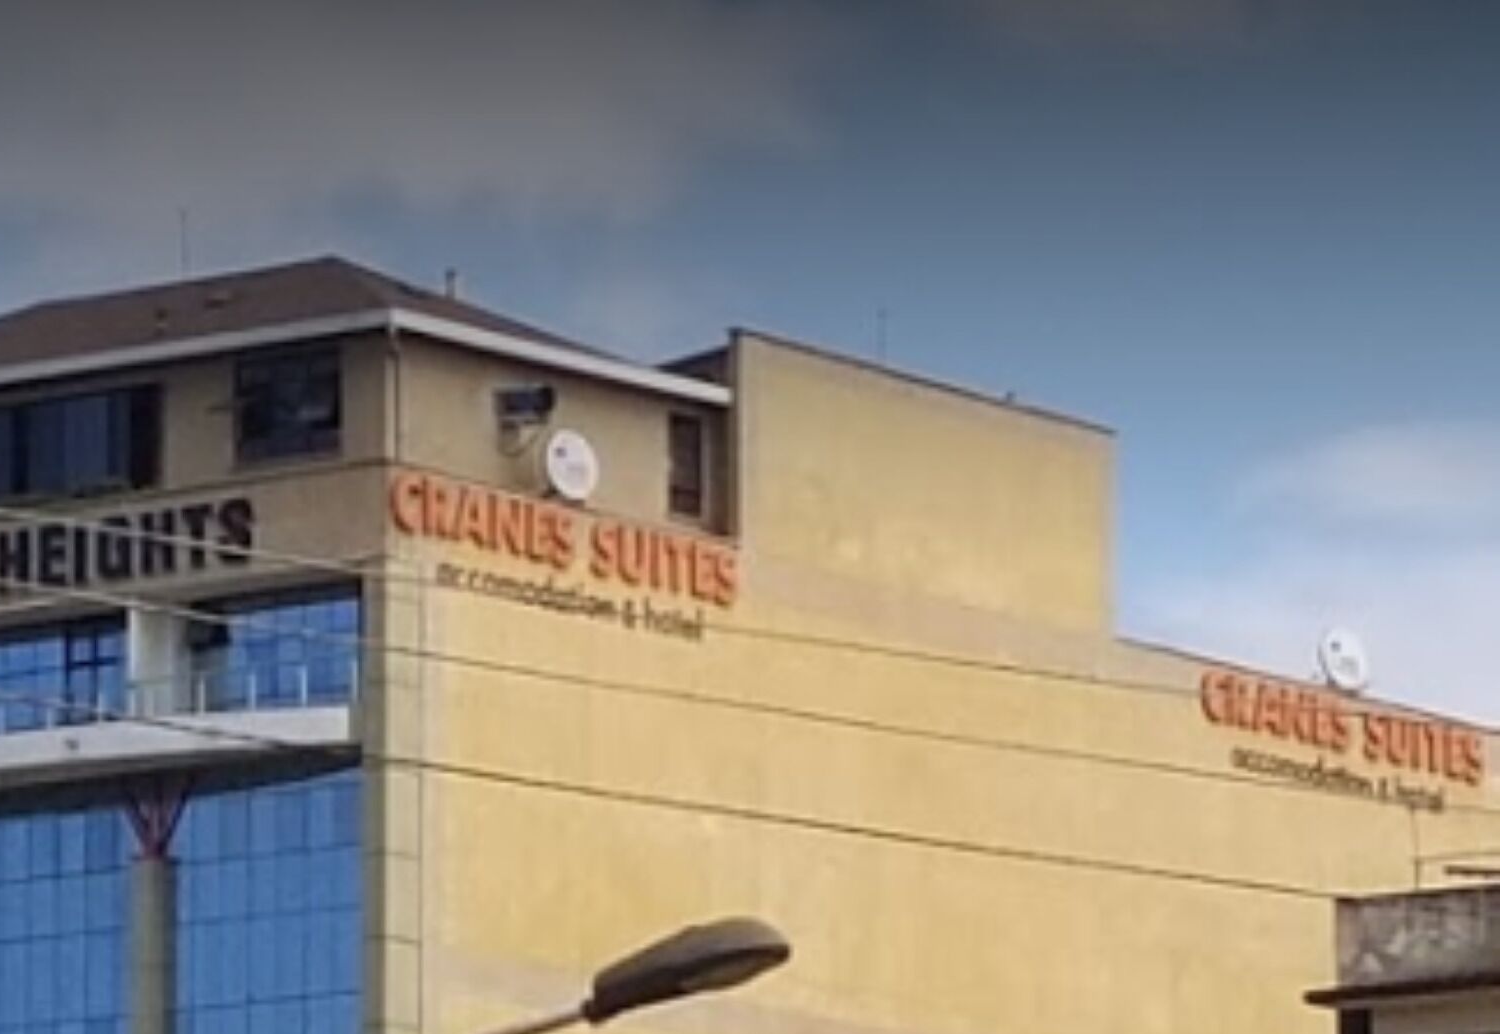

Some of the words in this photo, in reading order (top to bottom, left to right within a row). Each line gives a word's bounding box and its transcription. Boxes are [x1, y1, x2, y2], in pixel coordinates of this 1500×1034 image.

[390, 471, 573, 570] CRANES
[590, 519, 738, 608] SUITES
[1200, 669, 1348, 754] CRANES
[1362, 712, 1485, 786] SUITES
